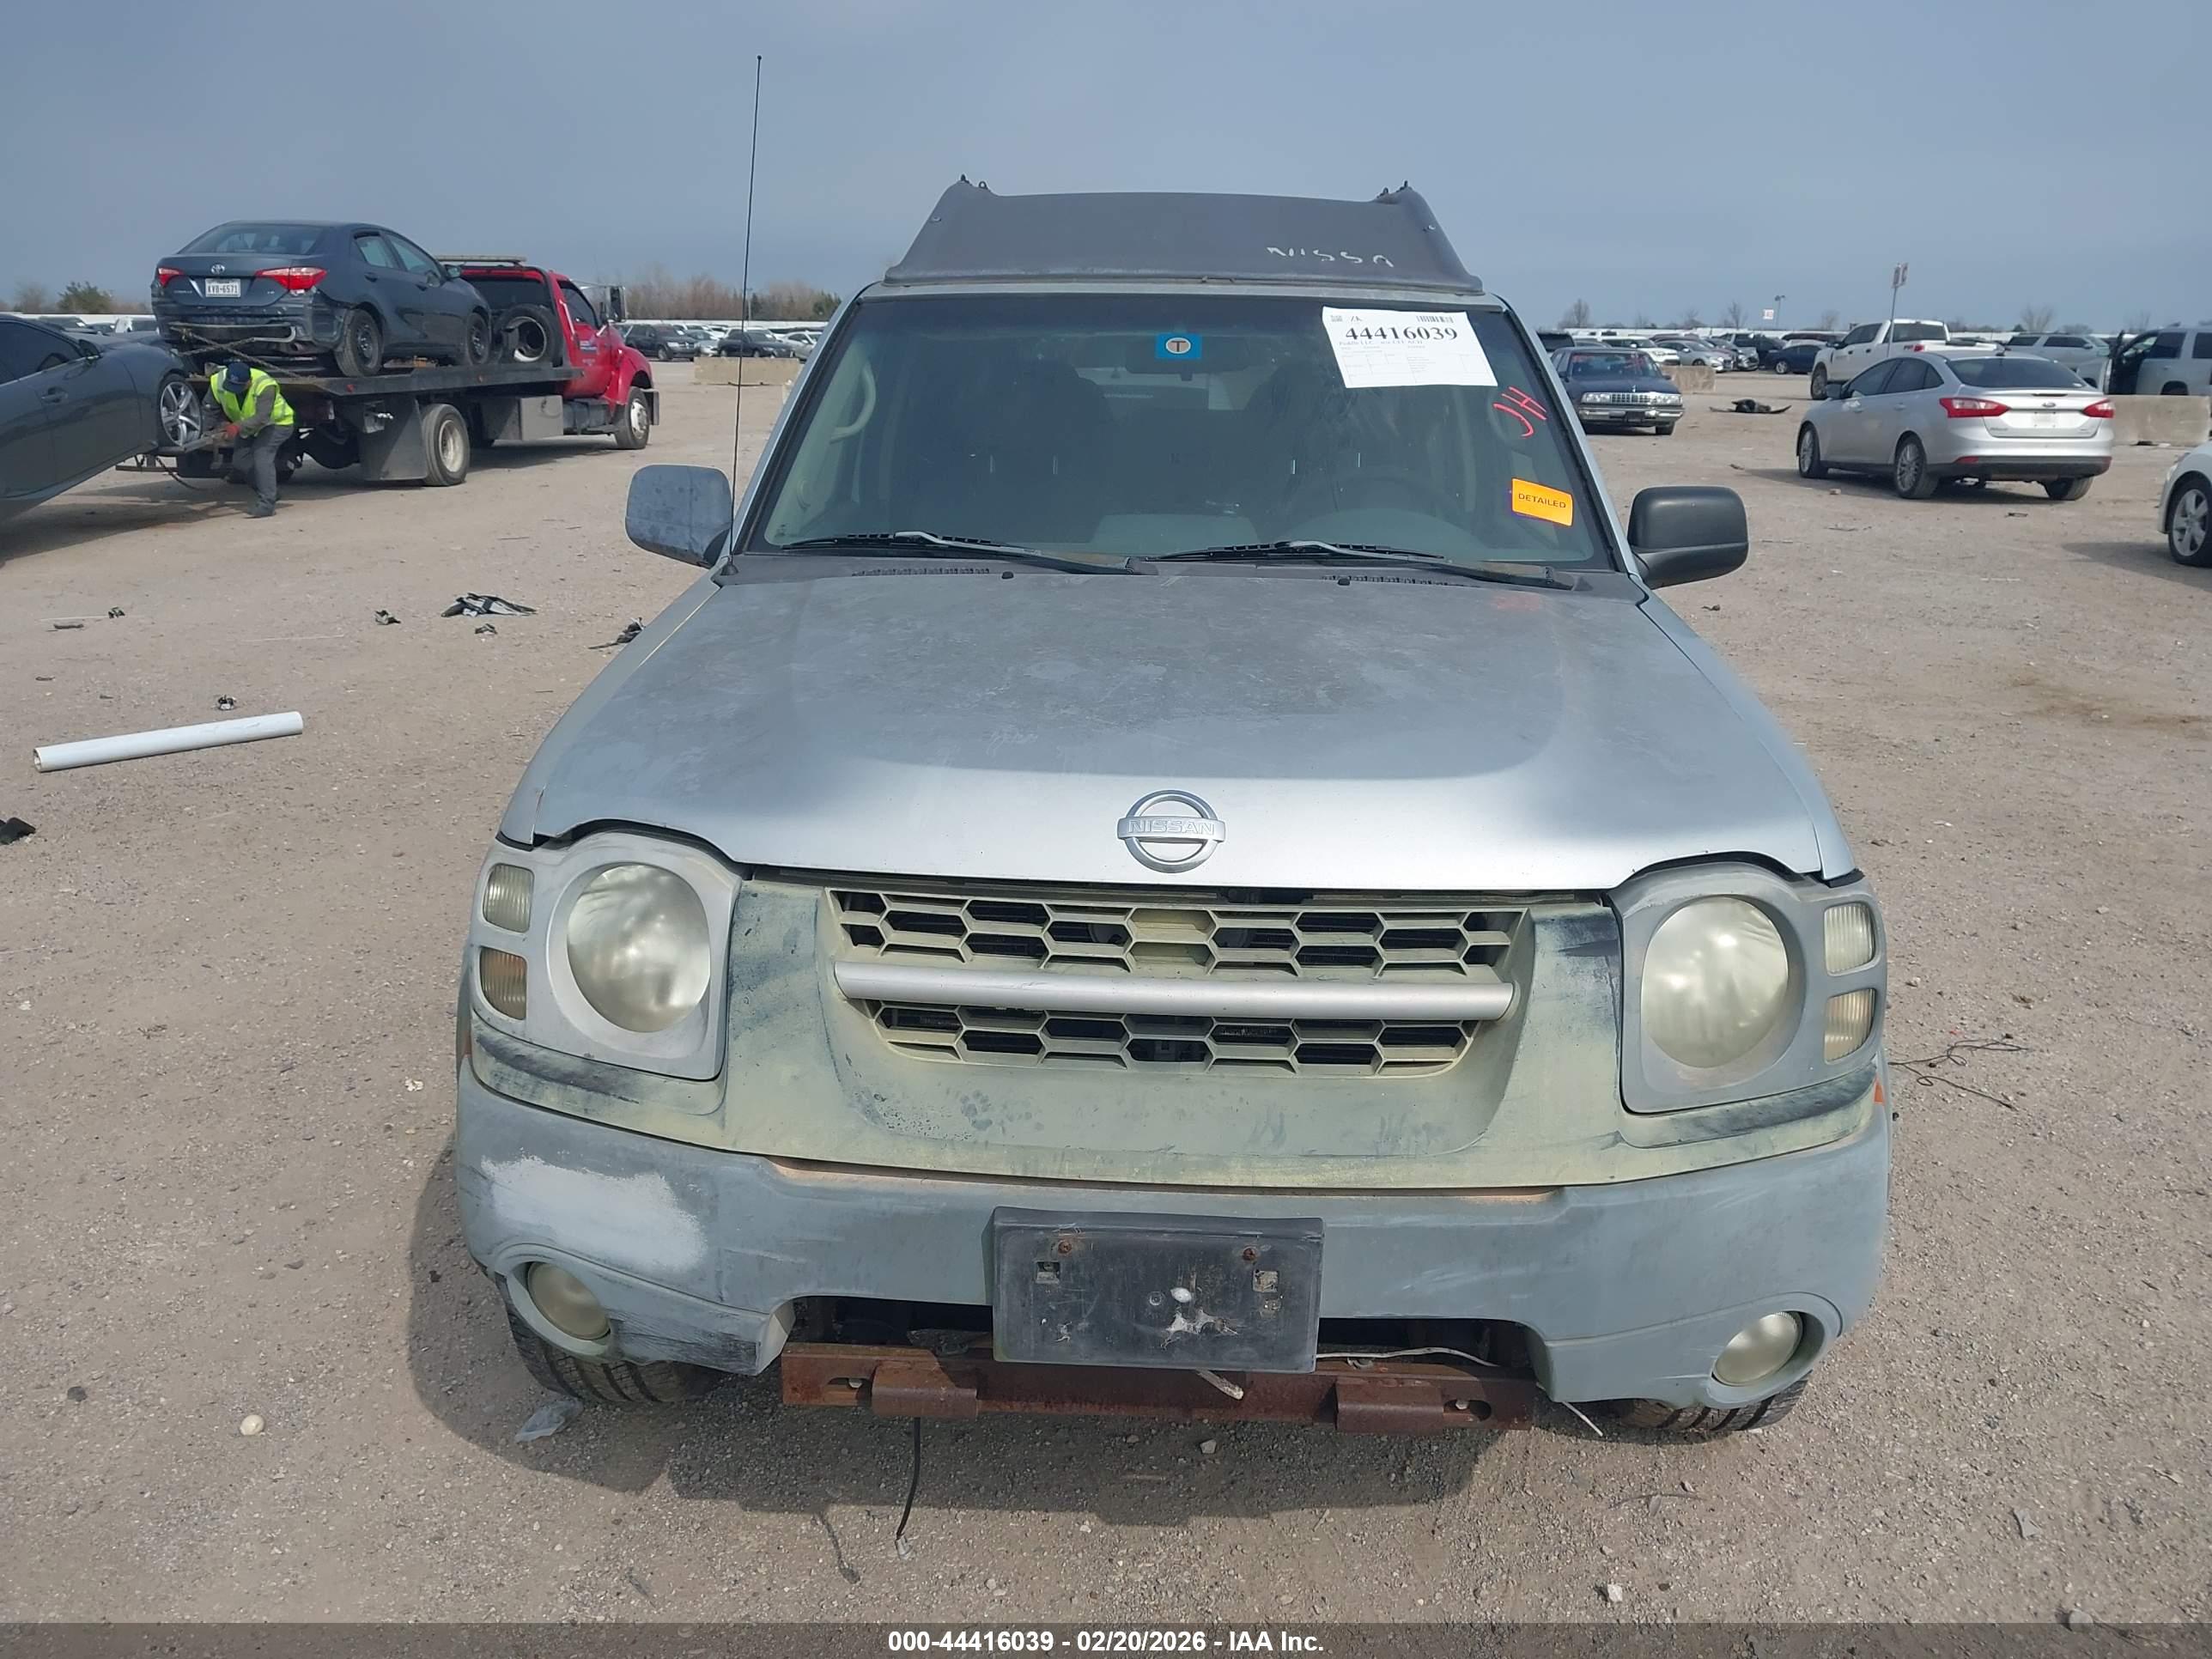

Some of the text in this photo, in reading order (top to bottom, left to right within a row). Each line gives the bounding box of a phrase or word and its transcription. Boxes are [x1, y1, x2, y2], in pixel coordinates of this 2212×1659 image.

[1345, 325, 1458, 341] 44416039
[1518, 493, 1566, 508] DETAILED
[1127, 819, 1215, 836] NISSAN
